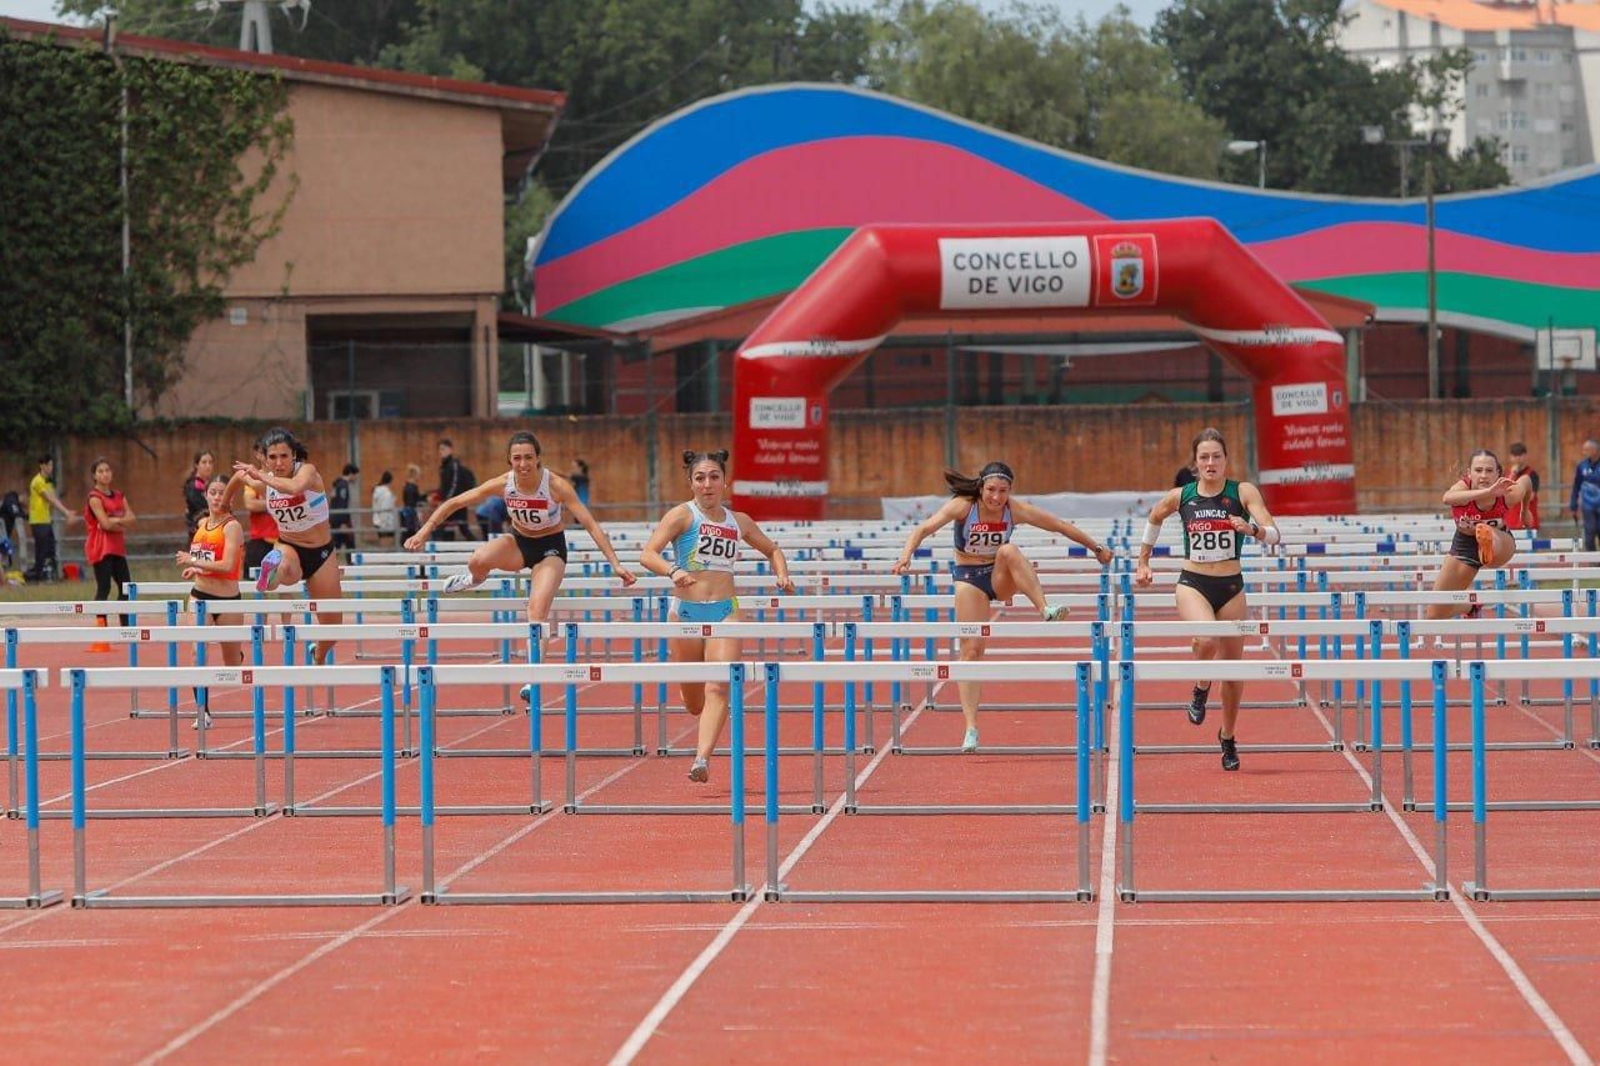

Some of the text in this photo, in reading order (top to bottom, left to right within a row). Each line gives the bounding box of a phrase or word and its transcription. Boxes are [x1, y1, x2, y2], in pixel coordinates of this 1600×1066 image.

[953, 250, 1077, 271] CONCELLO
[969, 275, 1064, 294] DE VIGO
[270, 500, 289, 508] VIGO
[508, 500, 528, 508] VIGO
[275, 505, 307, 523] 212
[512, 509, 542, 524] 116
[701, 525, 722, 537] VIGO
[1189, 522, 1212, 531] VIGO
[970, 532, 1003, 547] 219
[1191, 531, 1231, 551] 286
[698, 536, 736, 559] 260
